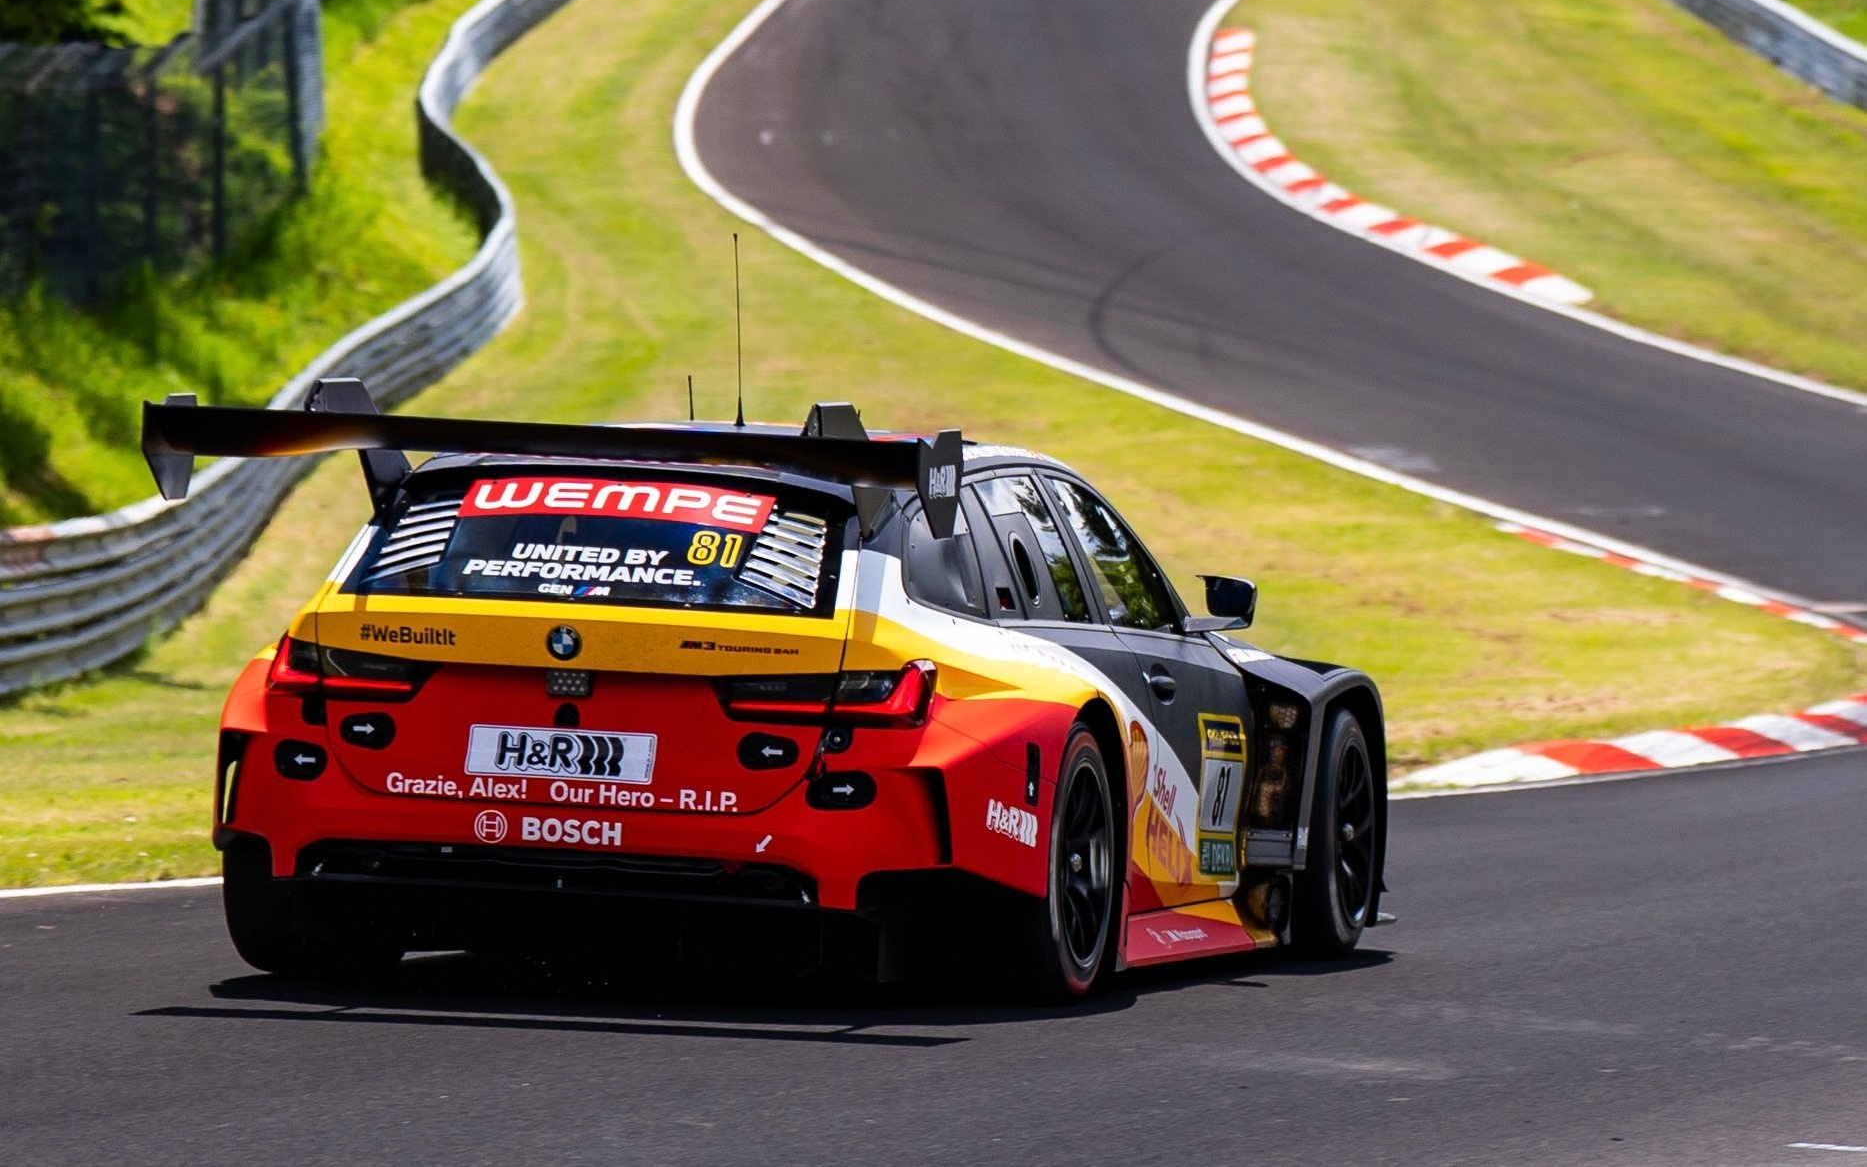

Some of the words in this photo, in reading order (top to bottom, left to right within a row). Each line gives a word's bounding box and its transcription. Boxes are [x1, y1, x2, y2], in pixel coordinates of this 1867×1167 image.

[474, 481, 762, 525] WEMPE
[511, 543, 620, 565] UNITED
[624, 549, 670, 565] BY
[686, 530, 744, 569] 81
[462, 559, 701, 586] PERFORMANCE.
[538, 583, 573, 594] GEN
[360, 624, 456, 646] #WeBuiltIt
[717, 644, 771, 655] TOURING
[773, 647, 799, 655] 24H
[386, 772, 463, 799] Grazie,
[469, 777, 527, 799] Alex!
[550, 781, 594, 804] Our
[599, 784, 655, 808] Hero
[679, 789, 737, 813] R.I.P.
[1153, 767, 1177, 816] Shell
[1211, 765, 1232, 827] 81
[521, 816, 622, 846] BOSCH
